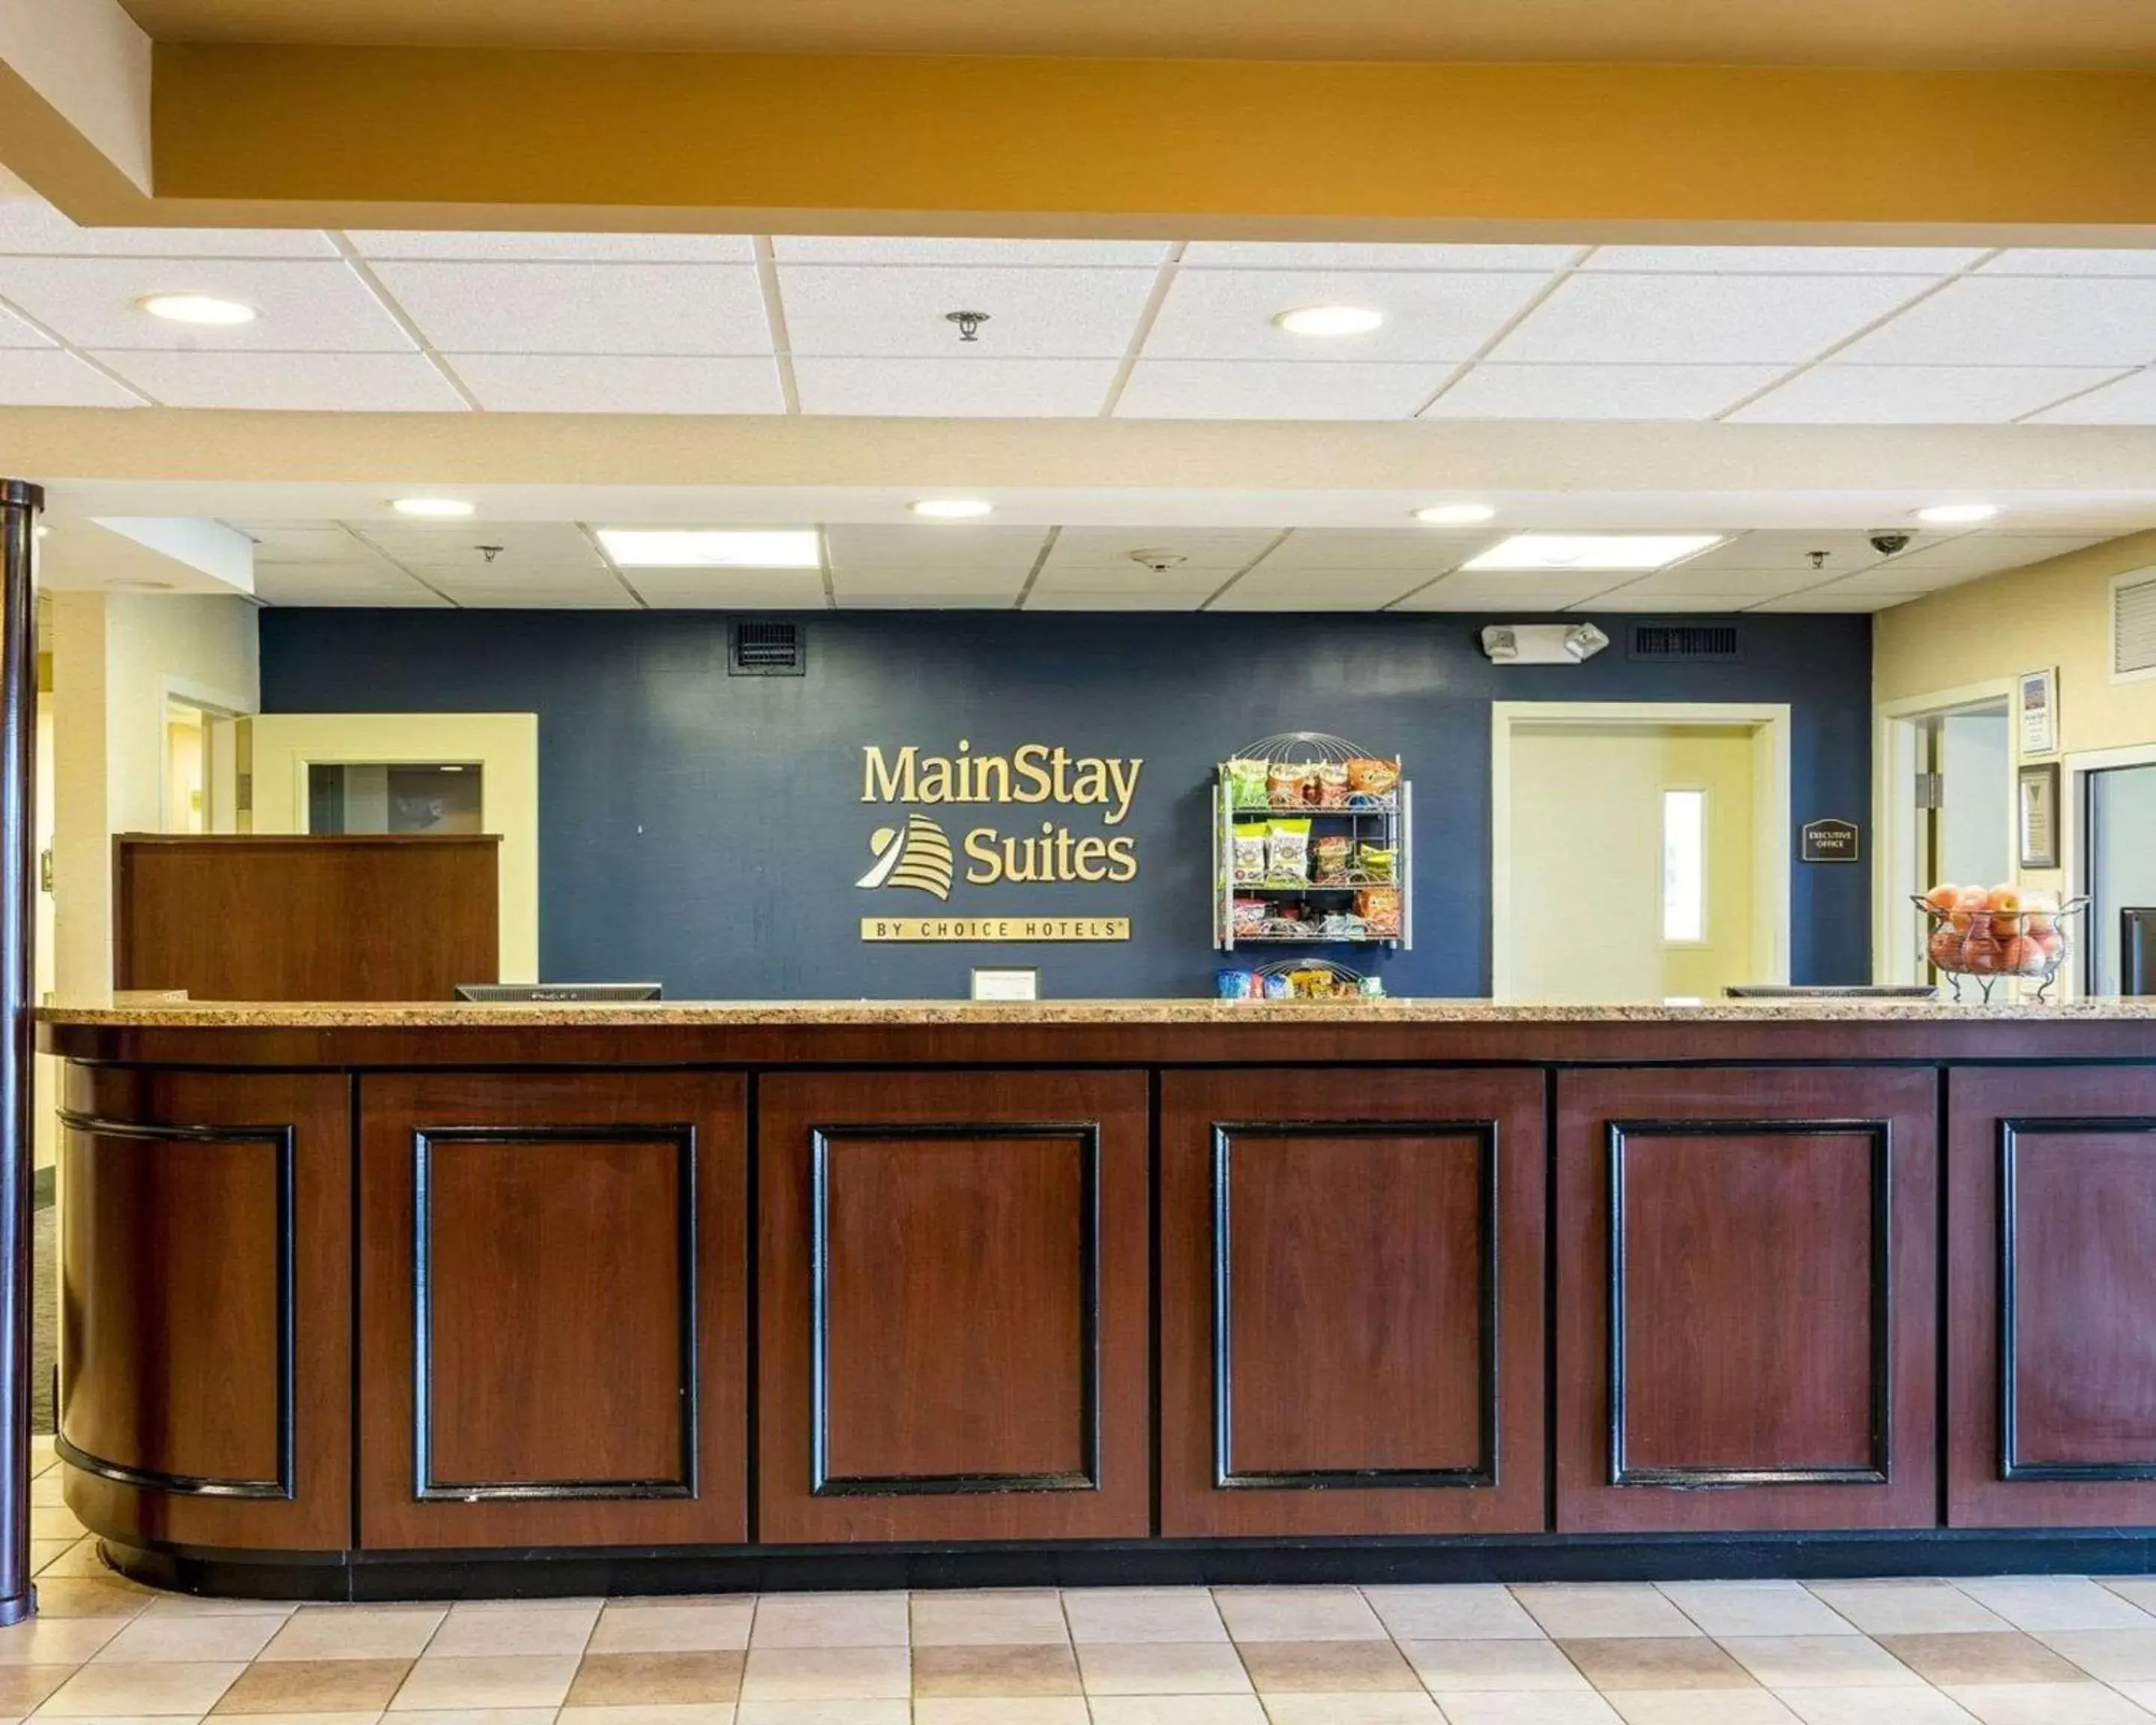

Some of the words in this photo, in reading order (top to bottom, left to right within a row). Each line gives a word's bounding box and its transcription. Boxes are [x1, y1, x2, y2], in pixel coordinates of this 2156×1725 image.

[861, 740, 1143, 824] MainStay
[963, 822, 1138, 884] Suites
[1809, 831, 1851, 839] EXECUTIVE
[877, 922, 902, 937] BY
[921, 922, 1008, 937] CHOICE
